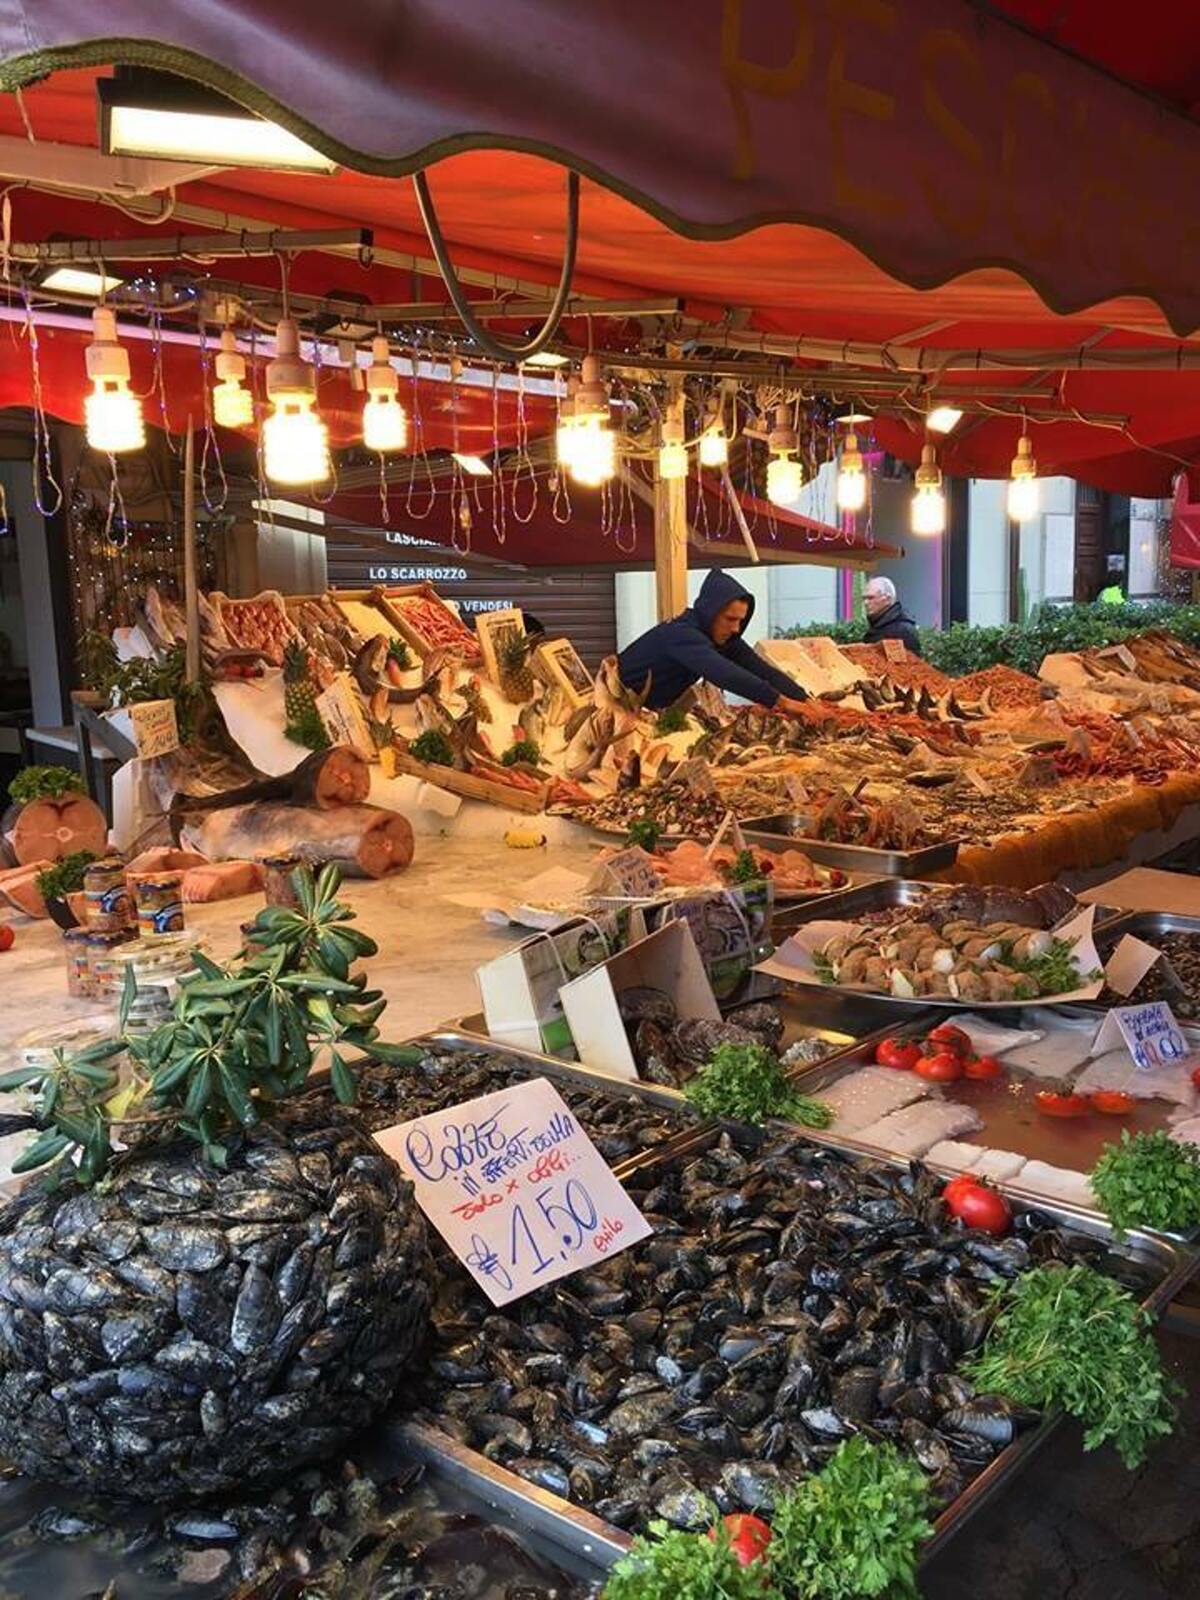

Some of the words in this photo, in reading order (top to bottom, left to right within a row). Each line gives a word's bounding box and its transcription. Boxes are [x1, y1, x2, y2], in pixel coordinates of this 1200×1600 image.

[369, 567, 388, 580] LO
[391, 567, 468, 580] SCARROZZO
[463, 600, 513, 612] VENDESI
[511, 1178, 598, 1275] 1,50
